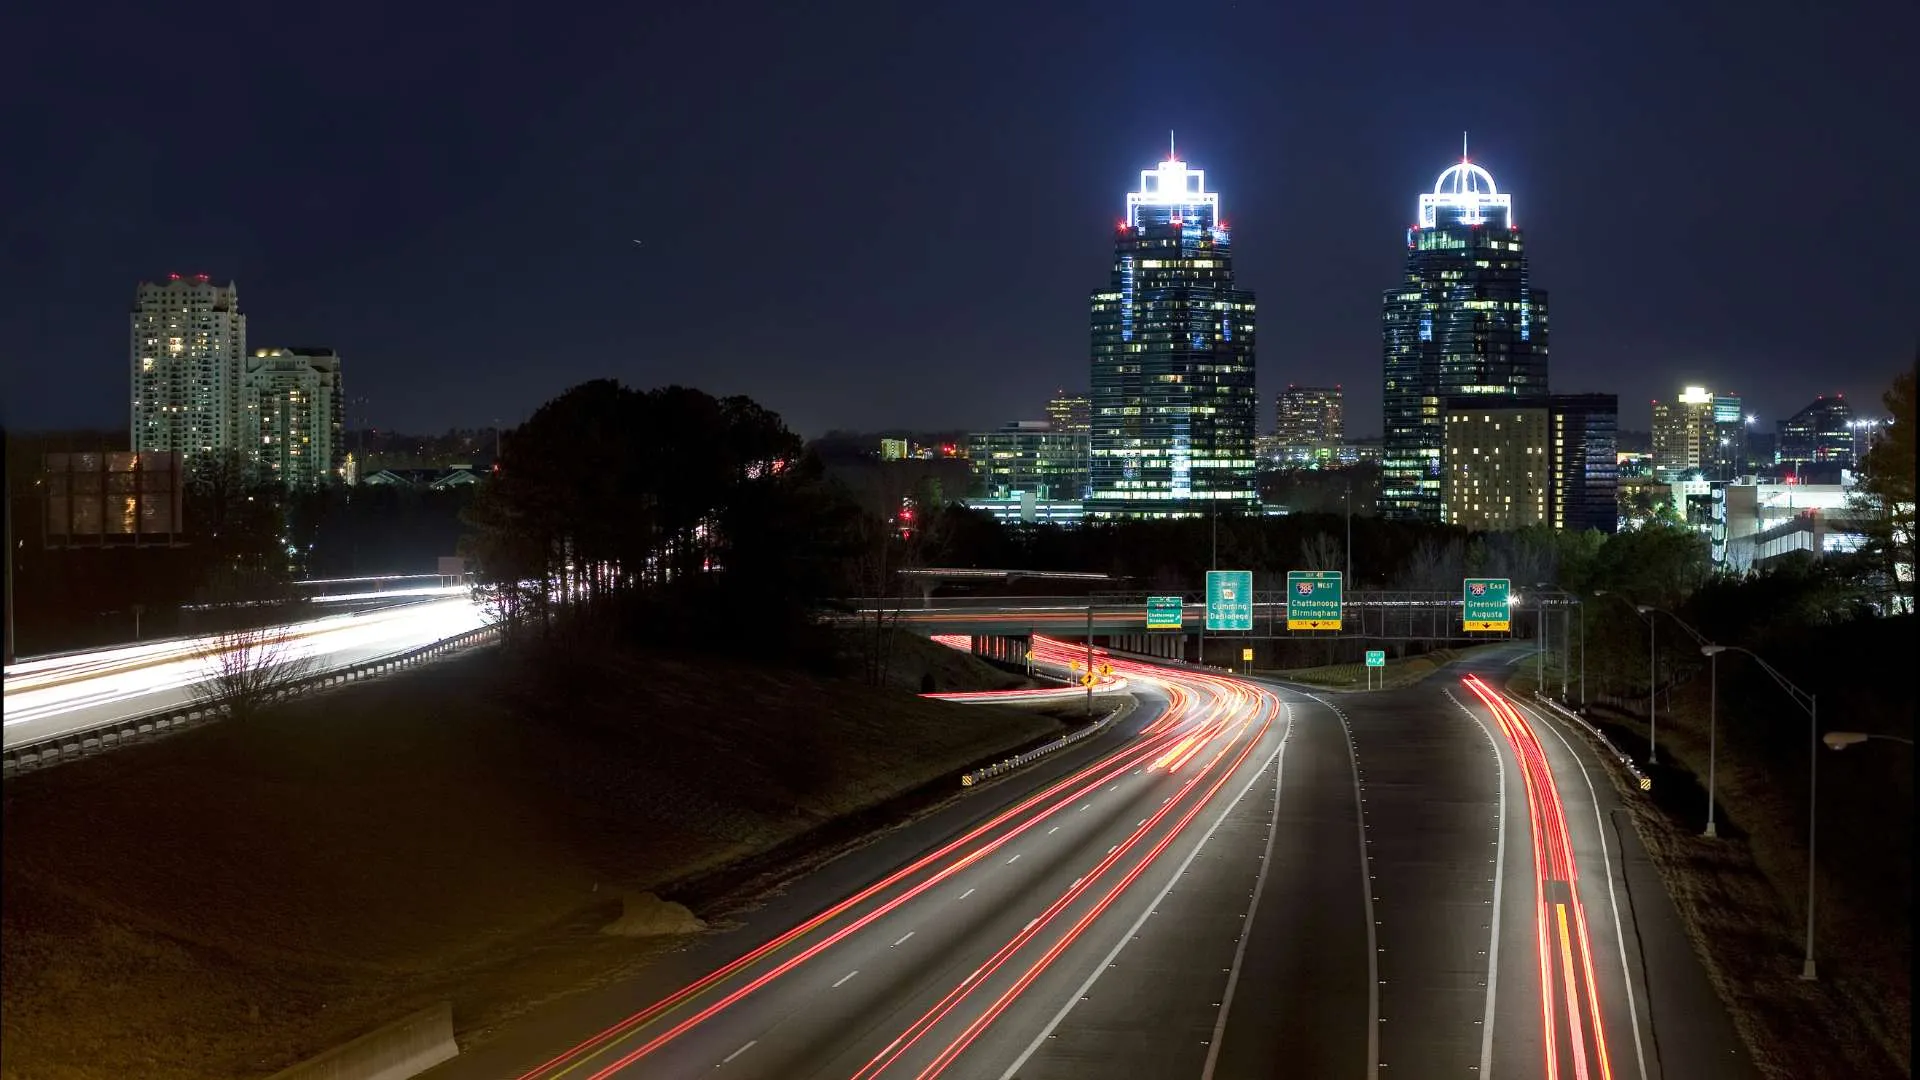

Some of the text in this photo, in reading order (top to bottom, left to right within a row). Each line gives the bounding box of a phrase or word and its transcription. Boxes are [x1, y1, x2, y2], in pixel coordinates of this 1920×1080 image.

[1212, 603, 1248, 611] Cumming
[1291, 600, 1338, 608] Chattanooga
[1292, 610, 1337, 618] Birmingham
